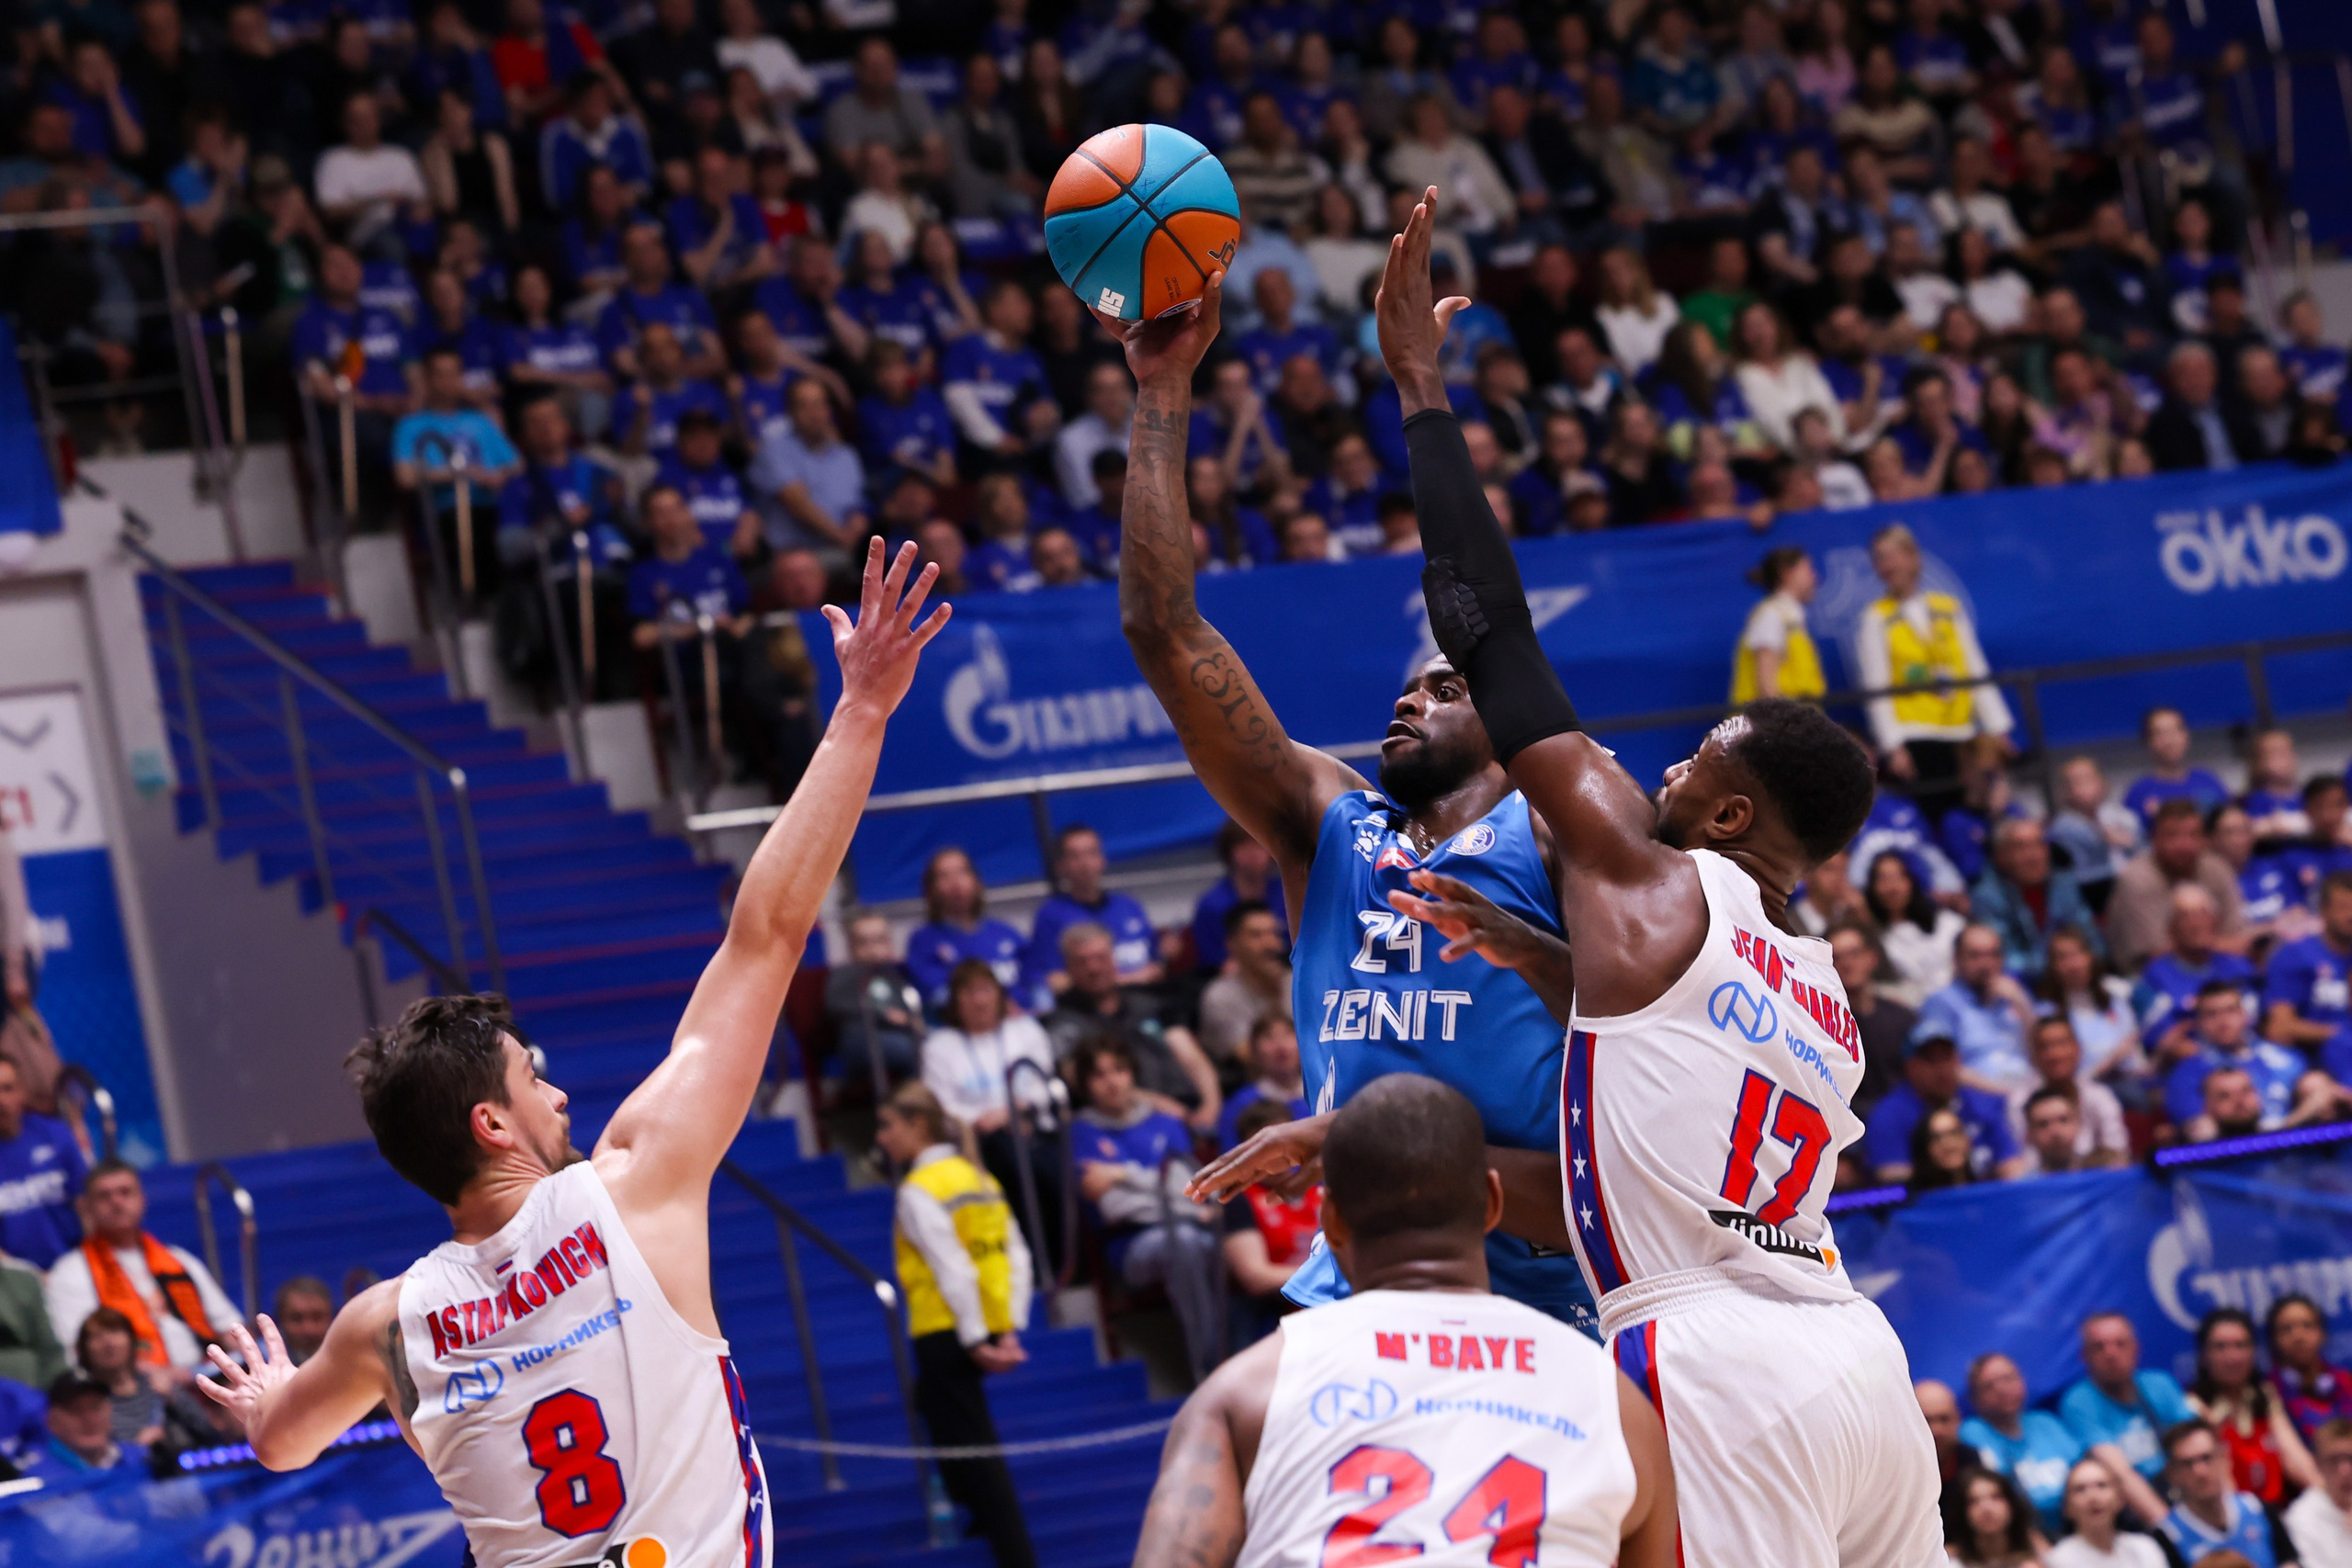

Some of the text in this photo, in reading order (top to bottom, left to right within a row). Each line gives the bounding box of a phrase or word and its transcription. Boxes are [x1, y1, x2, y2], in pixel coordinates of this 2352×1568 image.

[1350, 909, 1423, 975] 24
[1318, 989, 1474, 1043] ZENIT
[1719, 1066, 1833, 1230] 17
[1374, 1330, 1536, 1375] M'BAYE
[520, 1386, 628, 1540] 8
[1318, 1442, 1548, 1568] 24
